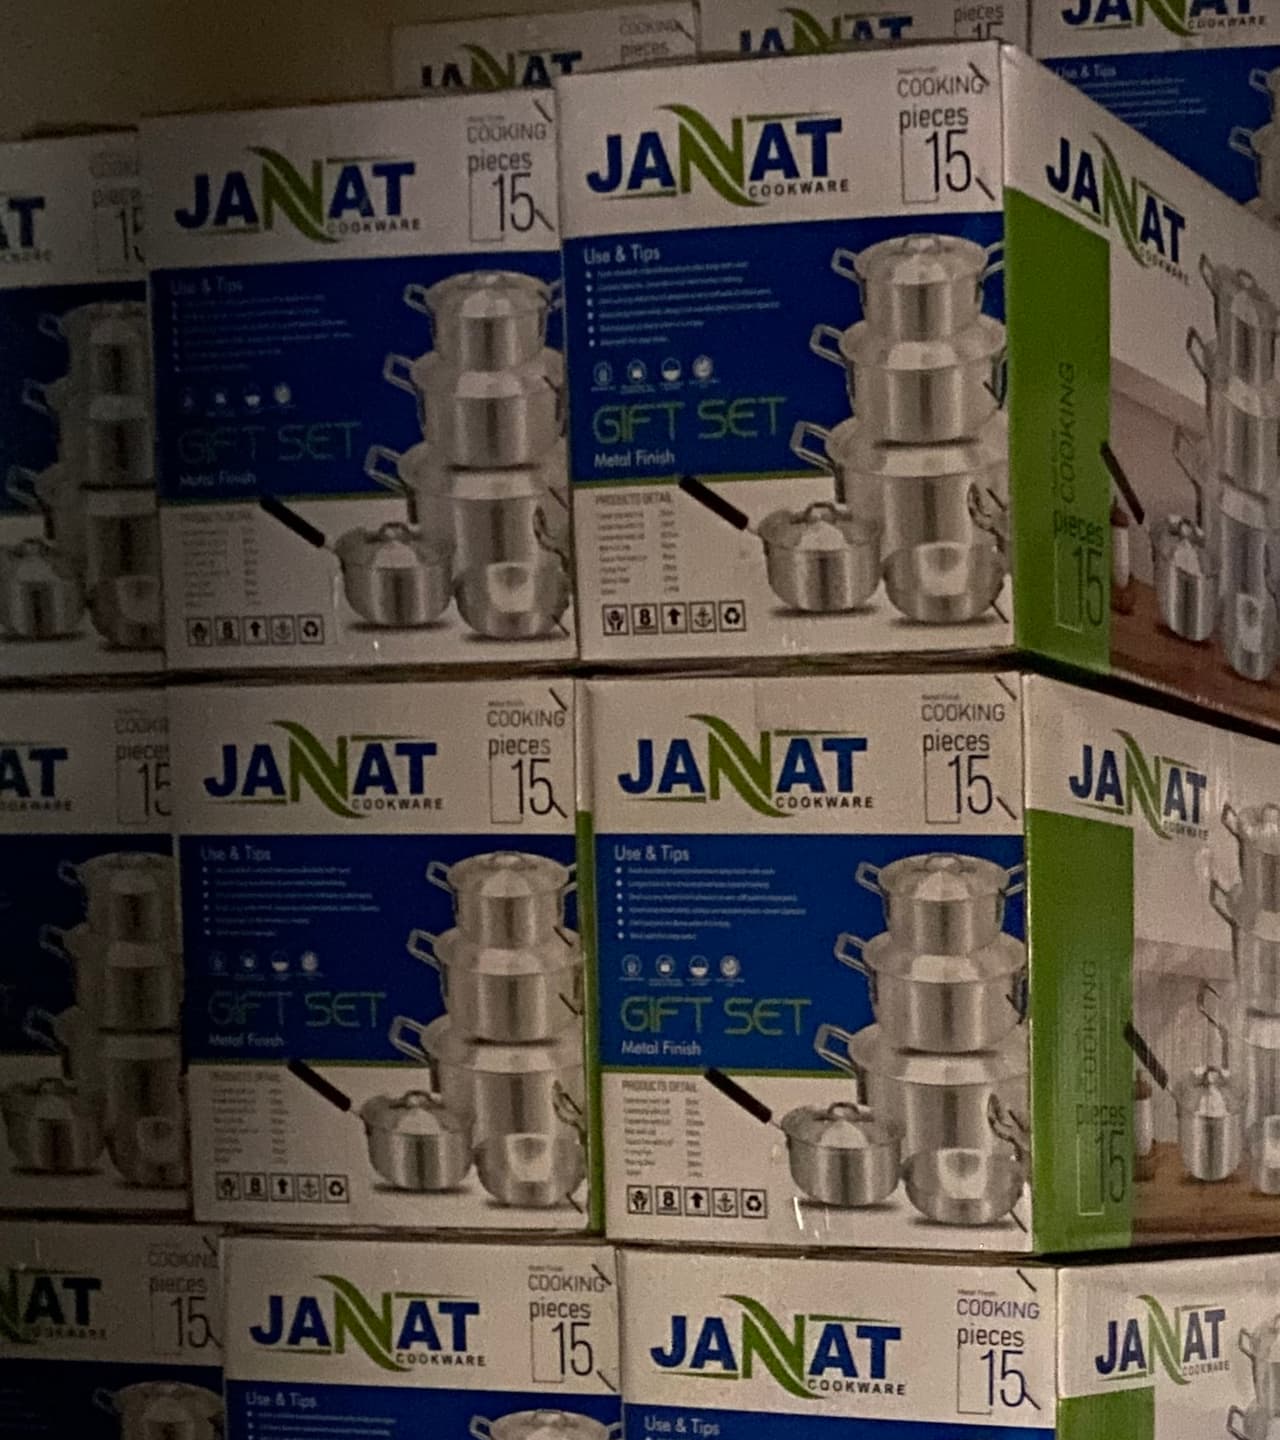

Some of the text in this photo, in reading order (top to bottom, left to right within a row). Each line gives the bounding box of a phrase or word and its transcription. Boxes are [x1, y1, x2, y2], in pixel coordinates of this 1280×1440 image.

[586, 104, 842, 207] JANAT
[923, 126, 968, 192] 15
[174, 146, 415, 243] JANAT
[750, 179, 850, 200] COOKWARE
[1046, 132, 1185, 267] JANAT
[920, 702, 1003, 722] COOKING
[203, 721, 437, 818] JANAT
[617, 713, 868, 817] JANAT
[922, 731, 987, 754] pieces
[352, 798, 444, 812] COOKWARE
[510, 757, 551, 814] 15
[777, 796, 874, 810] COOKWARE
[1069, 728, 1207, 838] JANAT
[614, 844, 690, 863] Use & Tips
[249, 1274, 479, 1371] JANAT
[529, 1299, 589, 1321] pieces
[954, 1297, 1037, 1319] COOKING
[956, 1324, 1021, 1348] pieces
[551, 1321, 592, 1375] 15
[648, 1293, 901, 1398] JANAT
[1095, 1294, 1226, 1386] JANAT
[808, 1379, 907, 1396] COOKWARE
[980, 1347, 1023, 1407] 15
